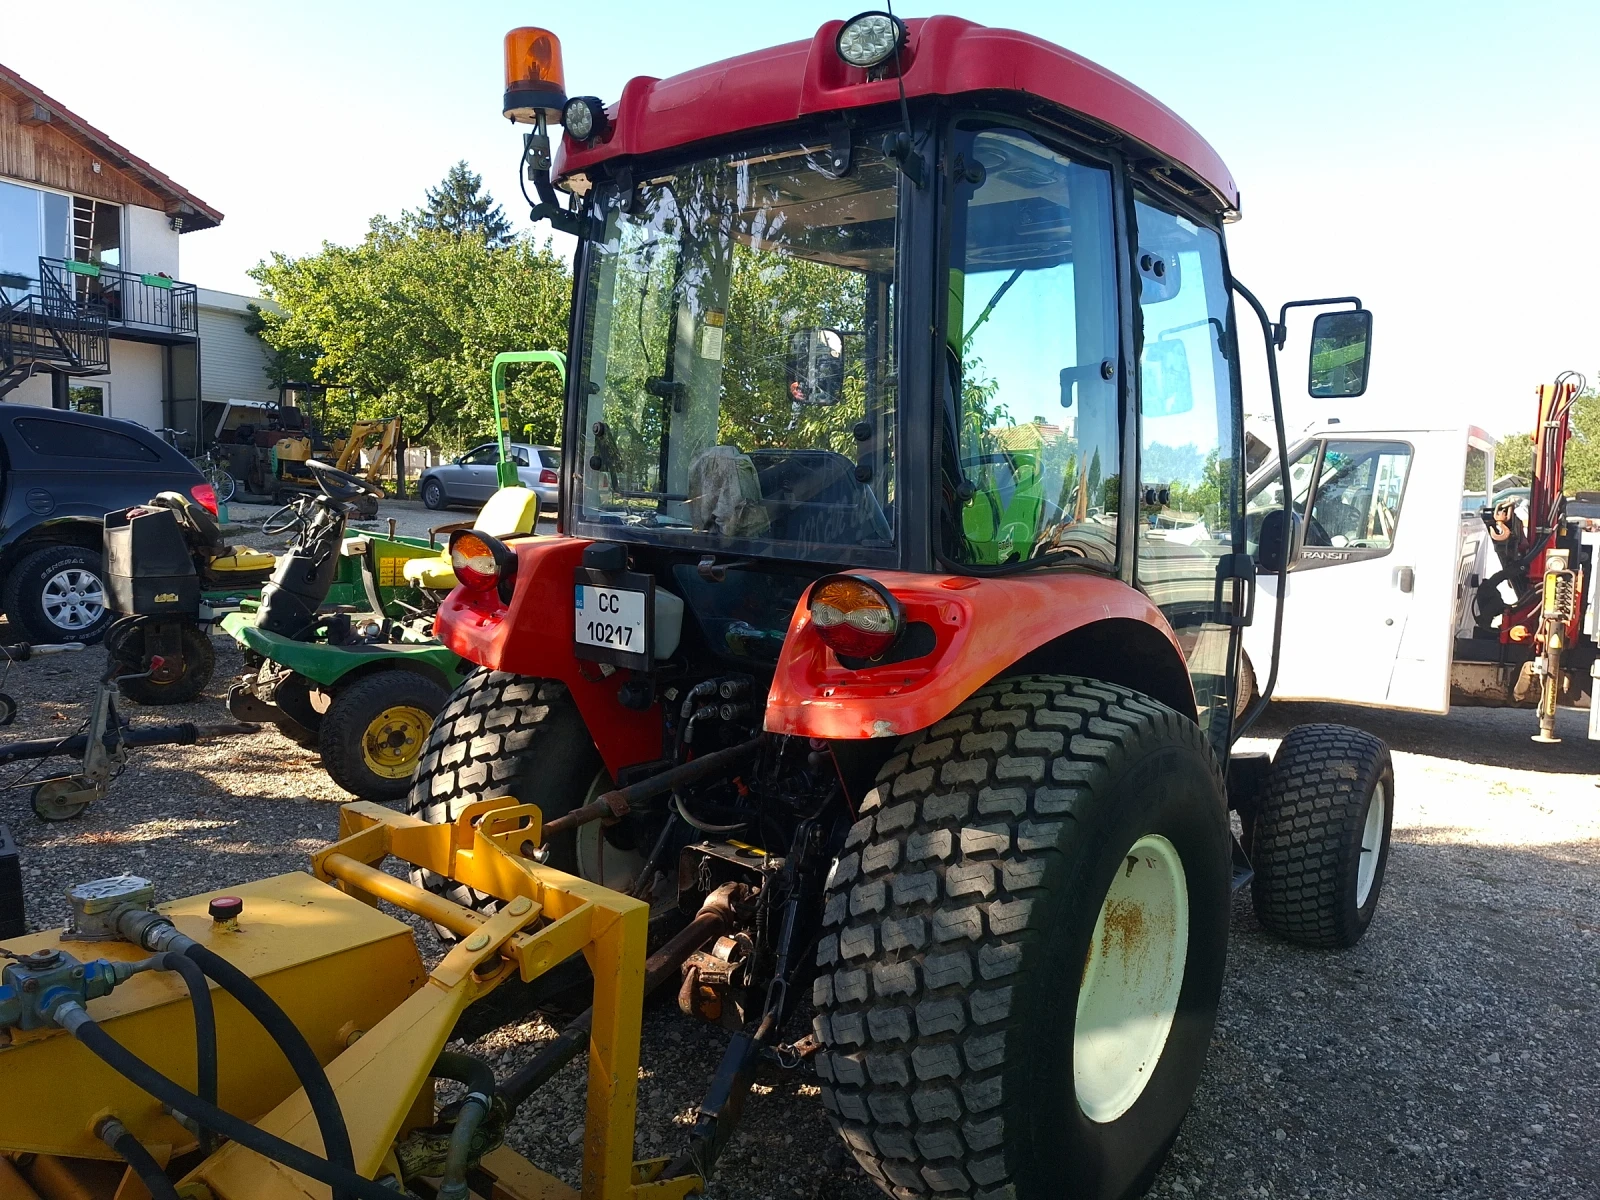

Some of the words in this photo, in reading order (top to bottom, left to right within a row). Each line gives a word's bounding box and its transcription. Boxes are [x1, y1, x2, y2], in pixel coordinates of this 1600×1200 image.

[41, 558, 85, 580] GENERAL
[599, 593, 619, 613] CC
[587, 621, 633, 646] 10217
